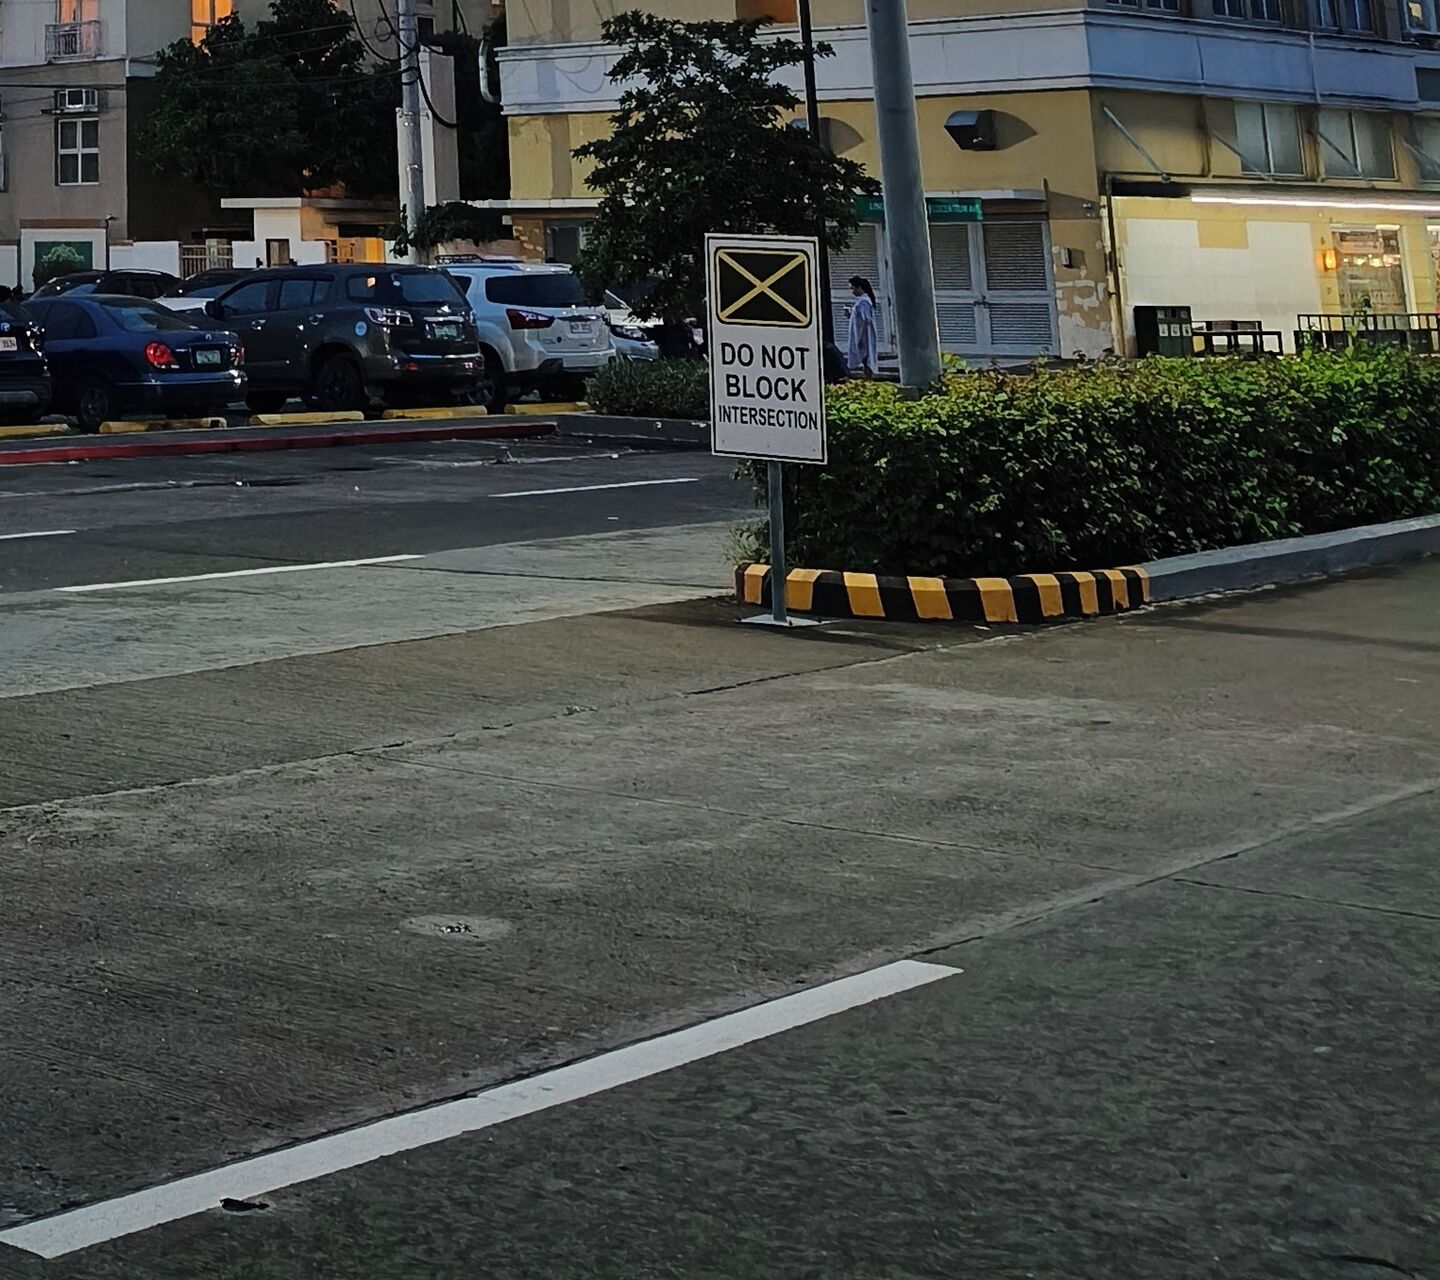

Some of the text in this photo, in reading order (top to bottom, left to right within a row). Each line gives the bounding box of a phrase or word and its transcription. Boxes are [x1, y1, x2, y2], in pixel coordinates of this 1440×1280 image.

[721, 342, 809, 370] DO NOT
[725, 374, 807, 402] BLOCK
[718, 404, 818, 430] INTERSECTION
